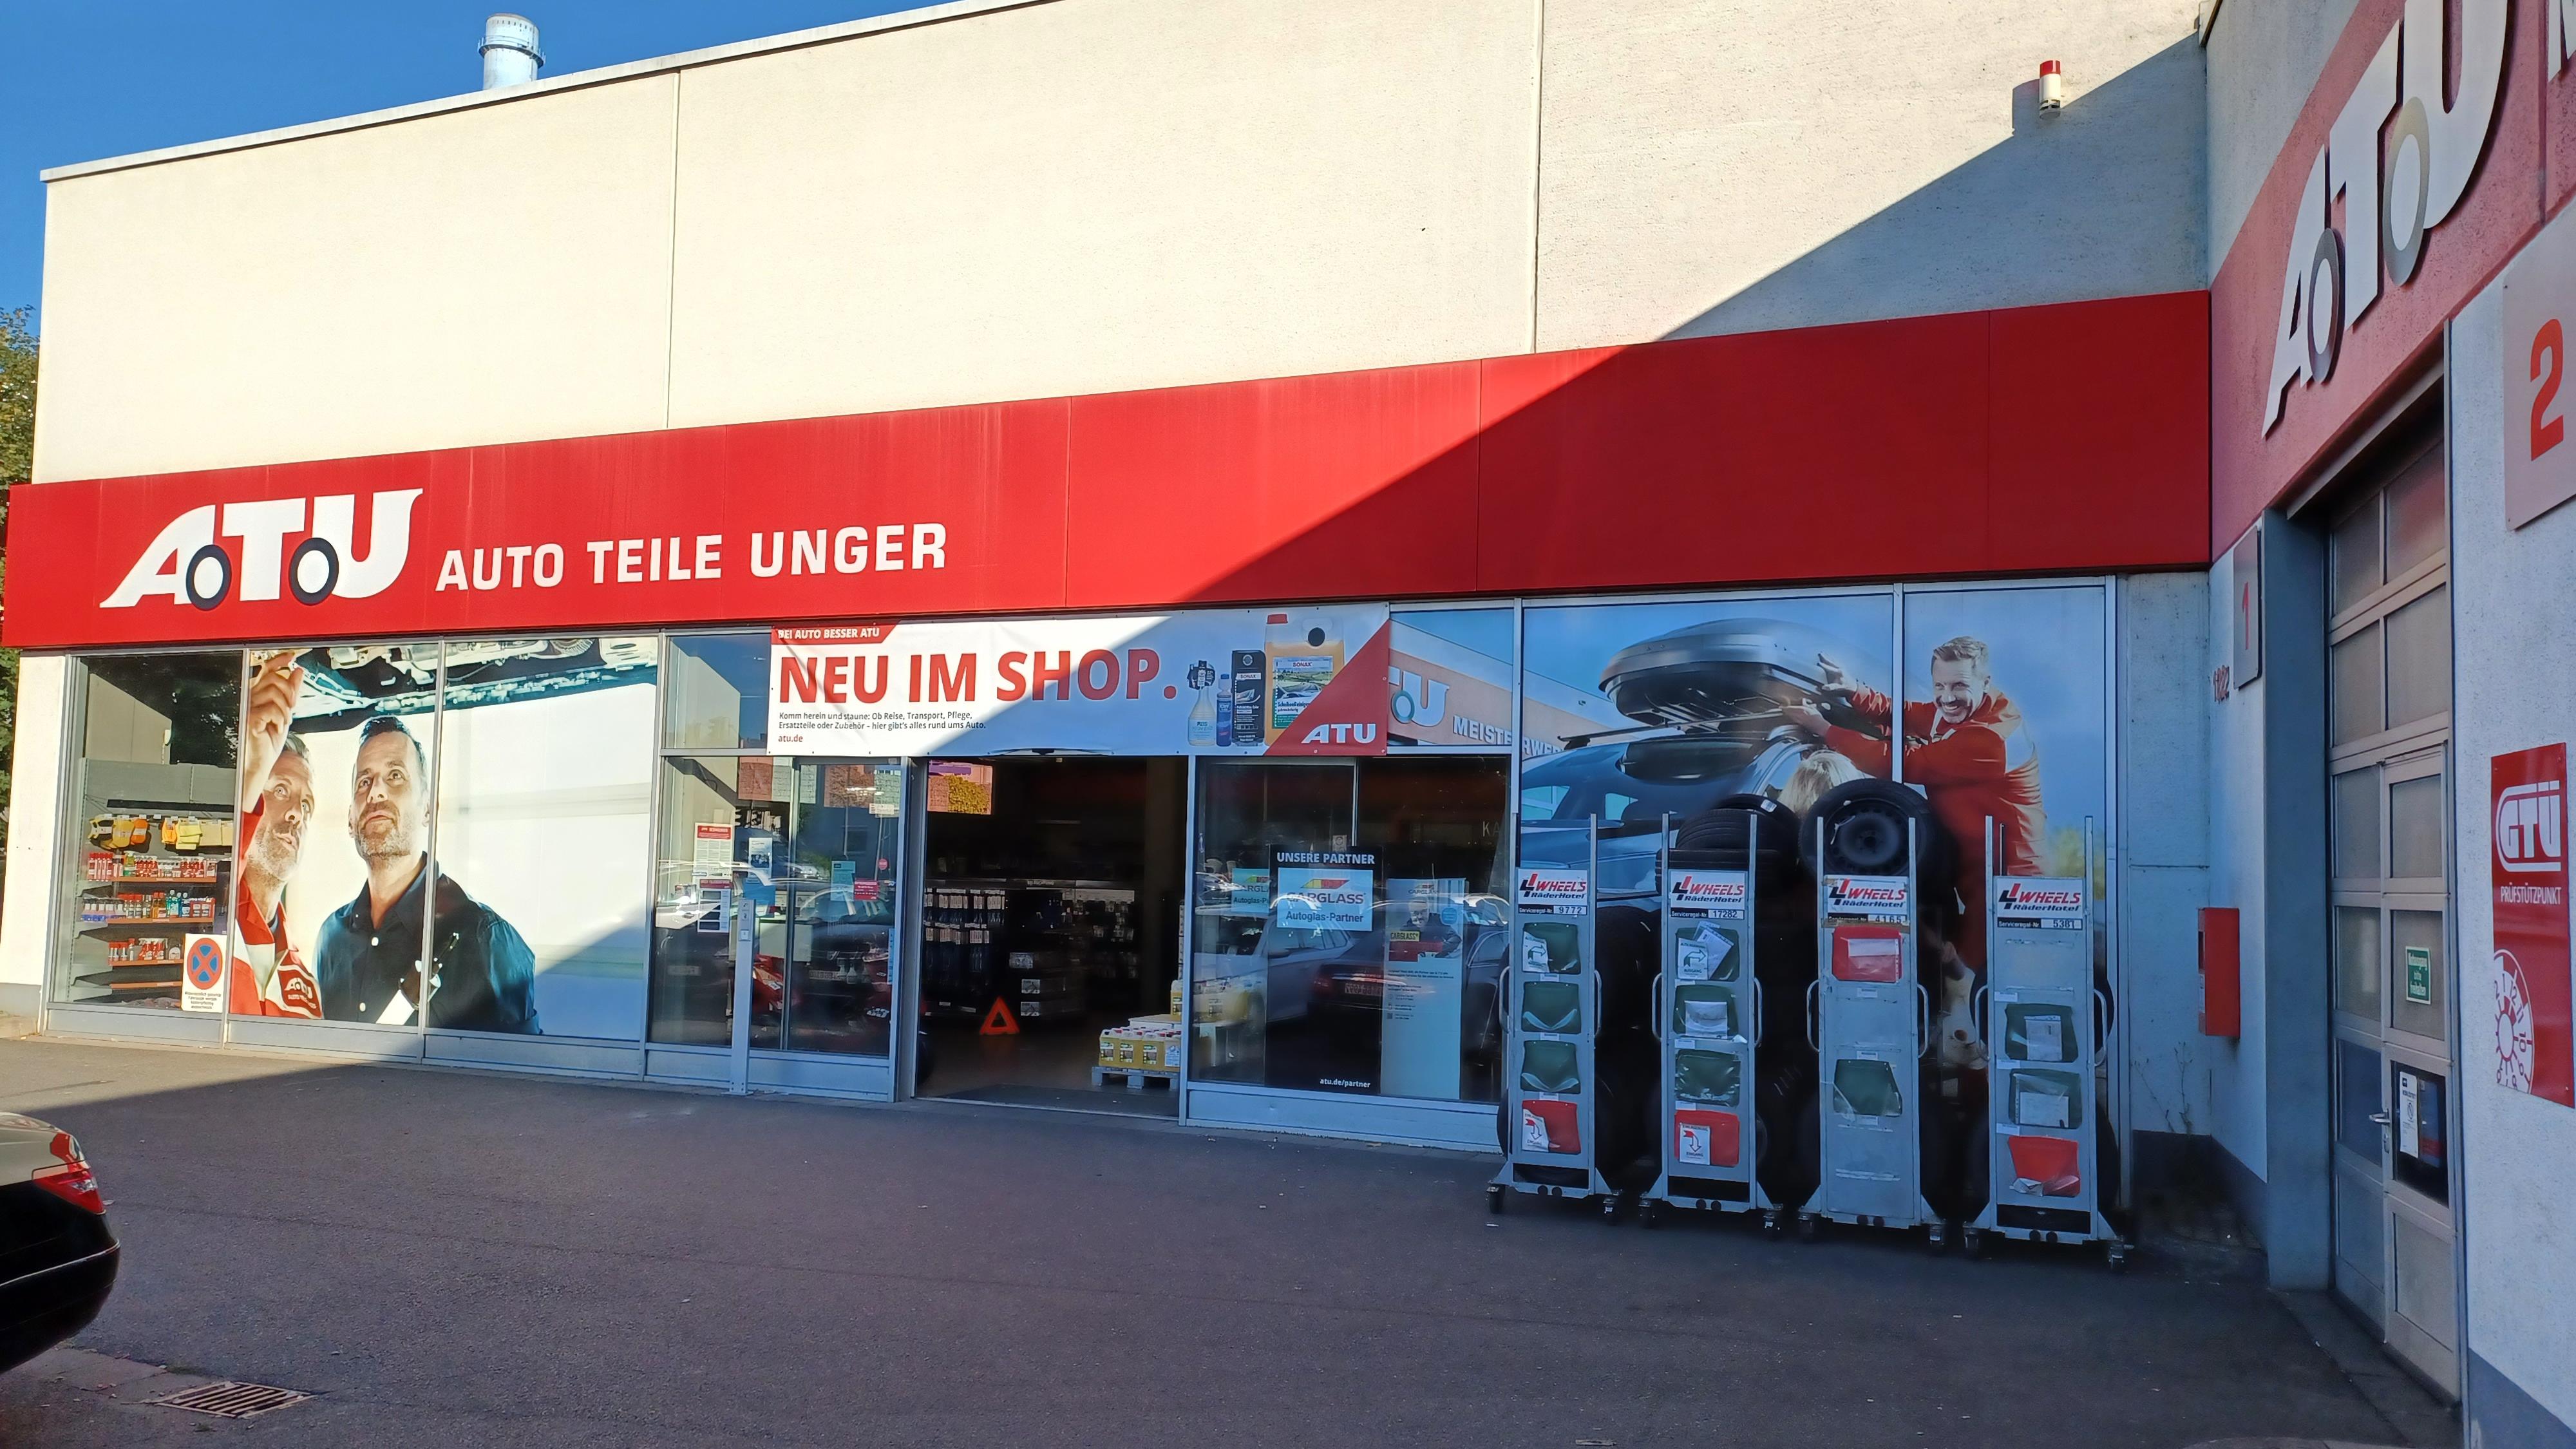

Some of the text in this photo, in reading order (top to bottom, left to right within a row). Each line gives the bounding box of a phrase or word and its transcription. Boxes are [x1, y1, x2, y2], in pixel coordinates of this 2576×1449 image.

[2262, 0, 2510, 439] ATU
[2530, 318, 2564, 462] 2
[99, 488, 423, 611] ATU
[435, 522, 947, 592] AUTO TEILE UNGER
[2241, 582, 2249, 650] 1
[778, 627, 880, 639] BEI AUTO BESSER ATU
[780, 649, 1177, 704] NEU IM SHOP.
[828, 712, 842, 720] und
[884, 712, 905, 721] Reise,
[907, 712, 945, 722] Transport,
[947, 711, 972, 721] Pflege,
[779, 721, 815, 730] Ersatzteile
[817, 721, 833, 730] oder
[835, 721, 865, 730] Zubehör
[872, 721, 886, 730] hier
[909, 721, 926, 729] alles
[928, 721, 946, 729] rund
[966, 721, 986, 729] Auto.
[1301, 723, 1376, 744] ATU
[1276, 852, 1376, 864] UNSERE PARTNER
[2500, 882, 2562, 905] PRÜFSTÜTZPUNKT
[1285, 911, 1364, 923] Autoglas-Partner
[1713, 910, 1738, 918] 17282
[1875, 915, 1902, 923] 4165
[1320, 1078, 1371, 1088] atu.de/partner
